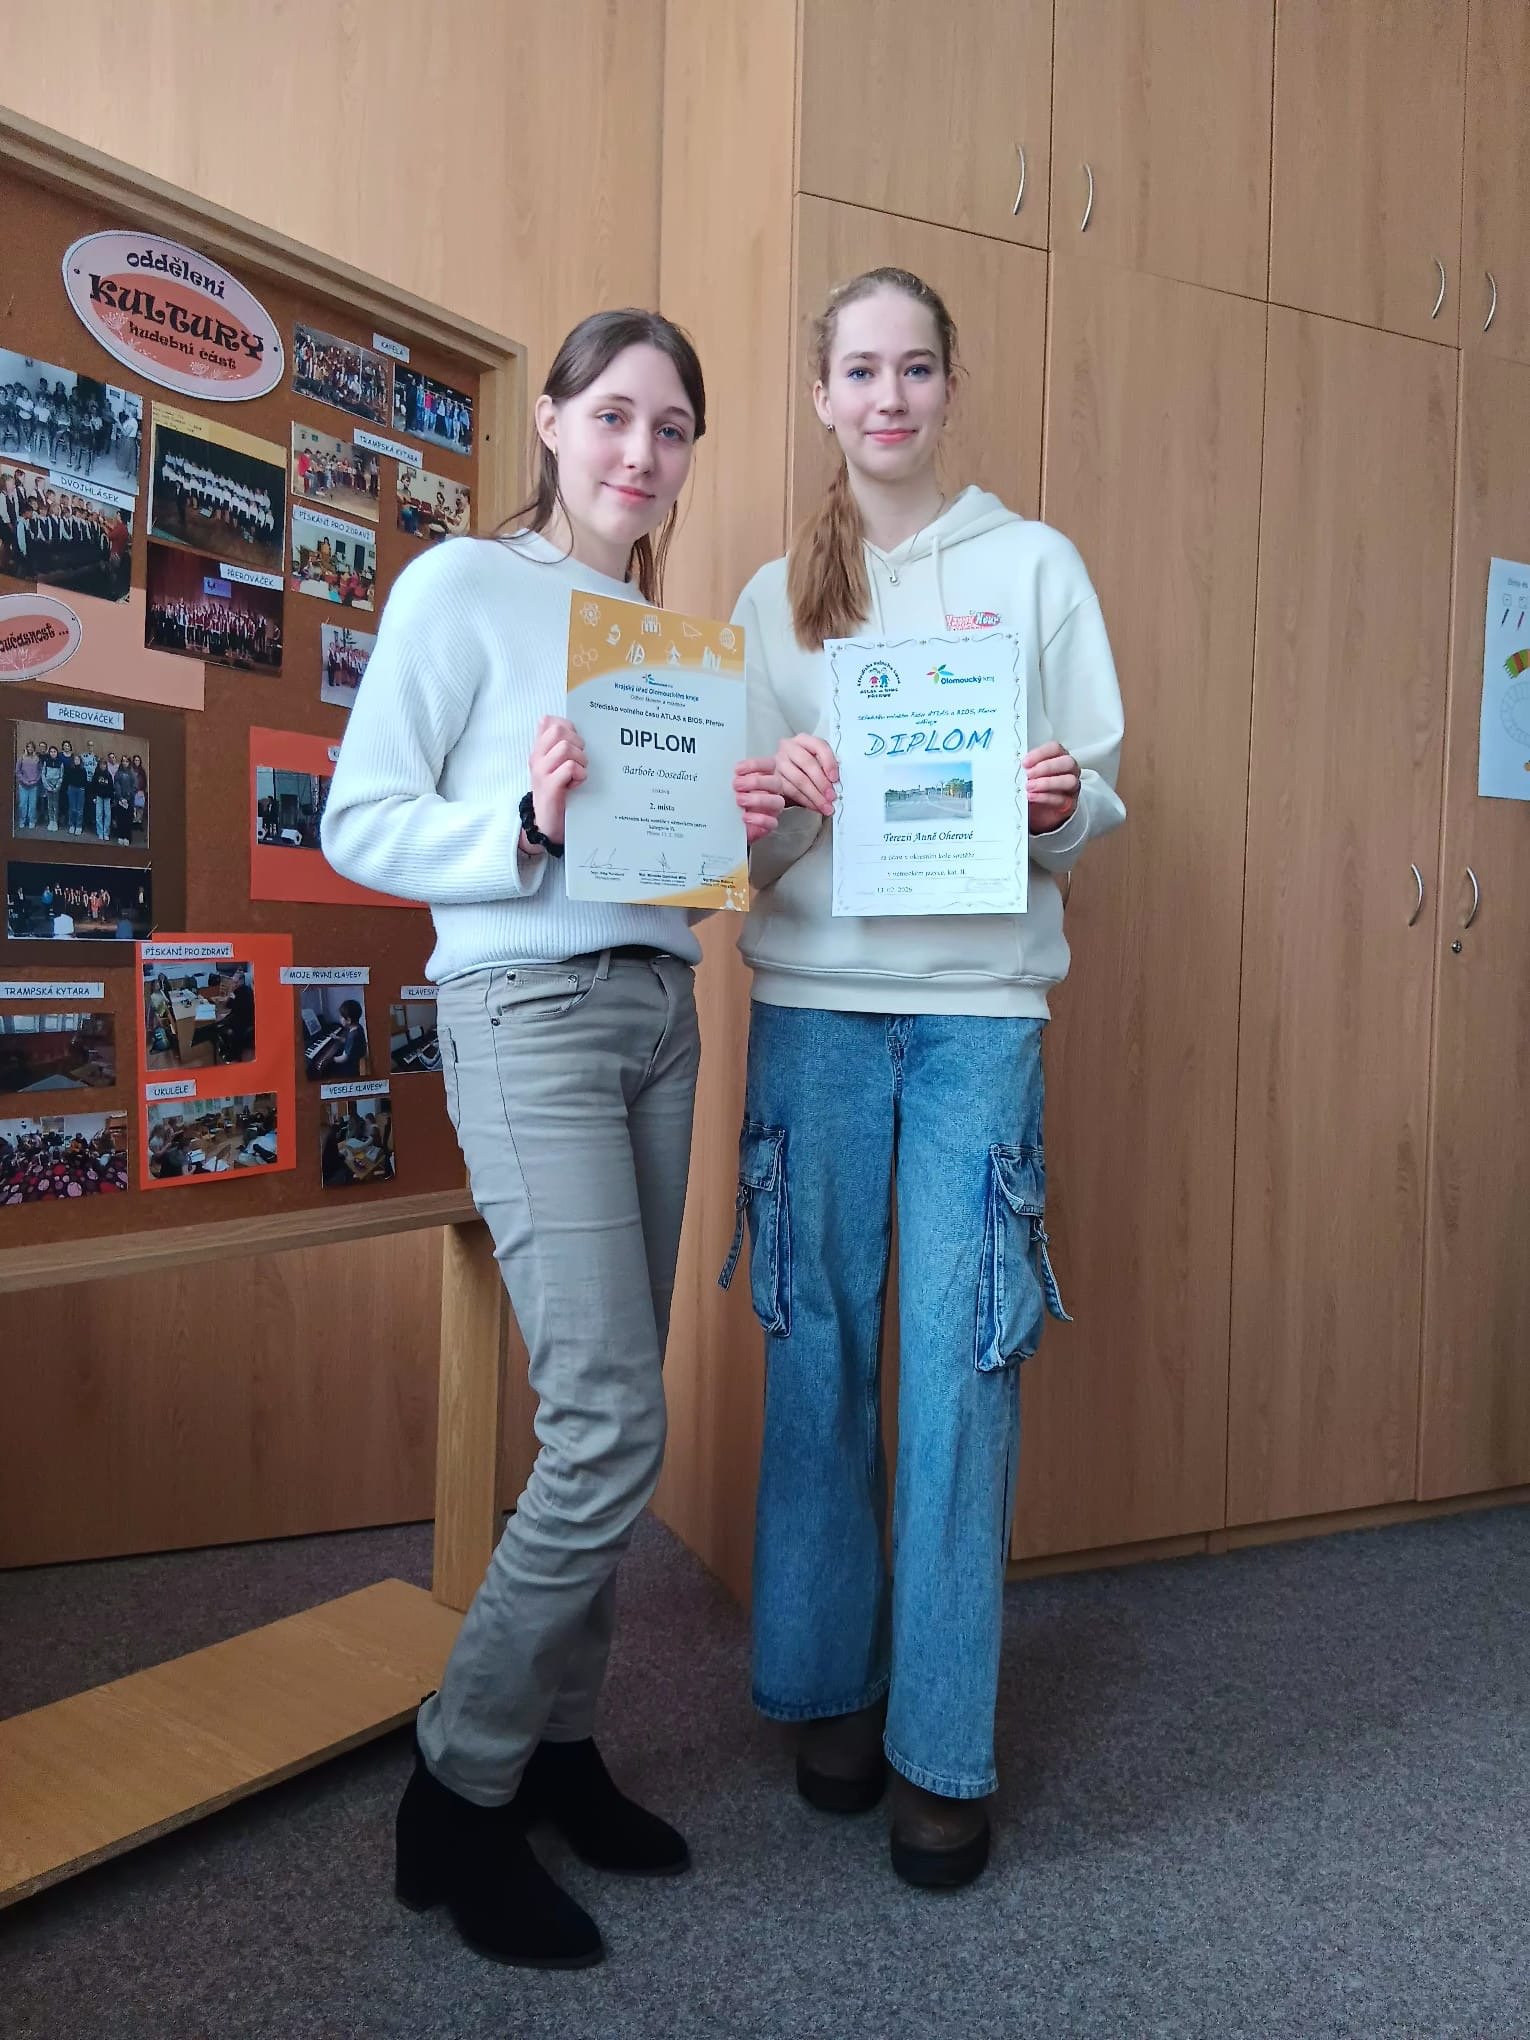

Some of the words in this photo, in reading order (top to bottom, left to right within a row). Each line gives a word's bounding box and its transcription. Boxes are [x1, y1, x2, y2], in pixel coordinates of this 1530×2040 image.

[88, 273, 264, 361] KULTURY
[128, 321, 194, 356] hudební
[199, 349, 237, 370] část
[60, 476, 119, 503] DVOJHLÁSEK
[299, 511, 331, 528] PÍSKÁNÍ
[331, 520, 345, 532] PRO
[345, 525, 370, 541] ZDRAVÍ
[227, 567, 275, 587] PŘEROVÁČEK
[940, 675, 982, 685] Olomoucký
[58, 707, 114, 724] PŘEROVÁČEK
[589, 701, 619, 712] Středisko
[619, 706, 644, 717] volného
[660, 713, 682, 722] ATLAS
[620, 727, 697, 754] DIPLOM
[864, 727, 993, 756] DIPLOM
[145, 945, 183, 956] PÍSKÁNÍ
[184, 947, 200, 956] PRO
[201, 946, 229, 956] ZDRAVÍ
[289, 971, 311, 979] MOJE
[4, 983, 54, 996] TRAMPSKÁ
[56, 986, 90, 996] KYTARA
